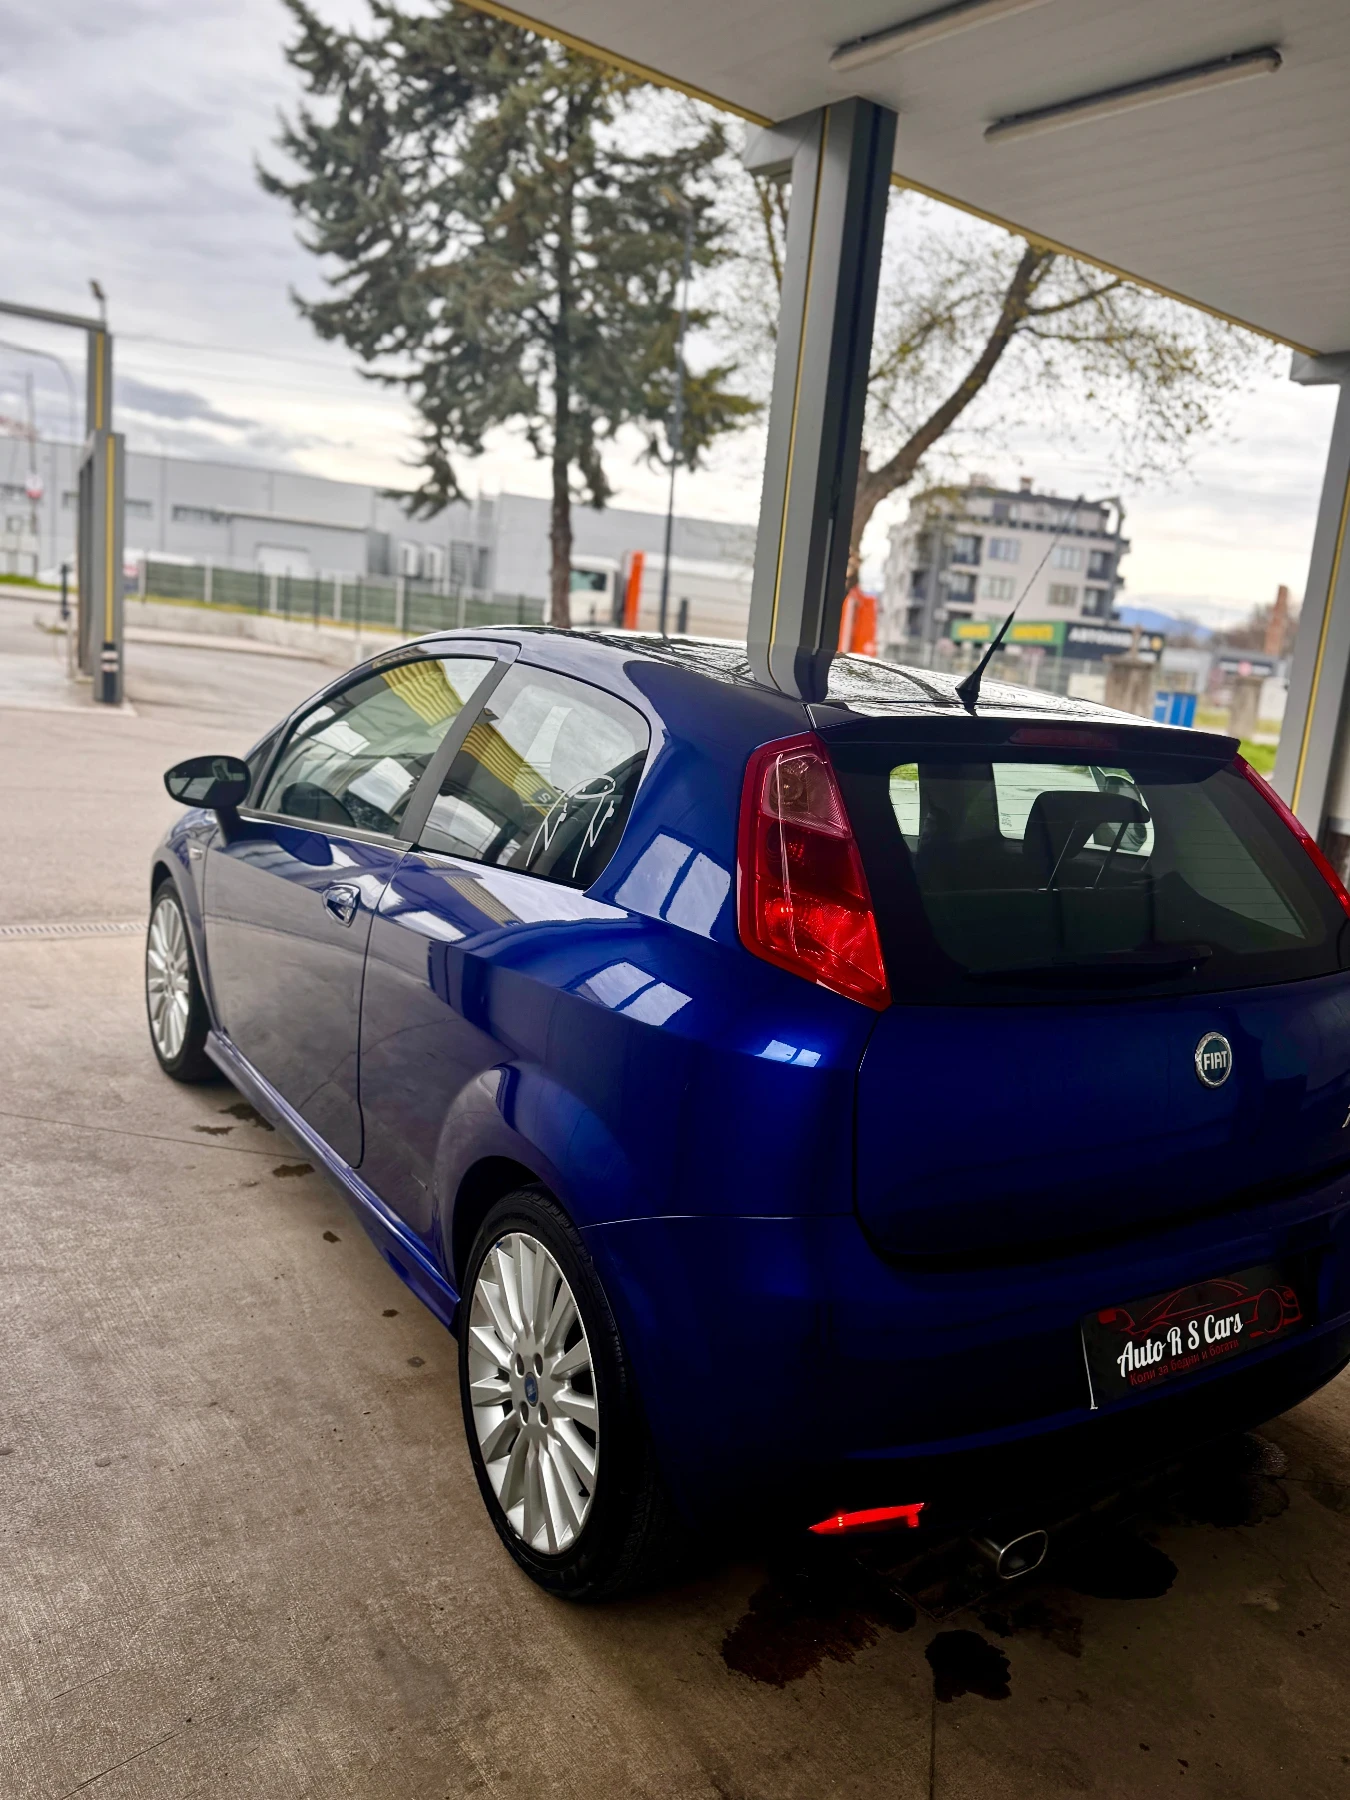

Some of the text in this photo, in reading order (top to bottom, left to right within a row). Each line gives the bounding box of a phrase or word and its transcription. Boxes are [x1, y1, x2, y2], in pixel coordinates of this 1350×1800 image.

[1203, 1050, 1228, 1071] FIAT
[1116, 1312, 1244, 1378] Auto R S Cars
[1130, 1339, 1239, 1386] Коли за бедни и богати
